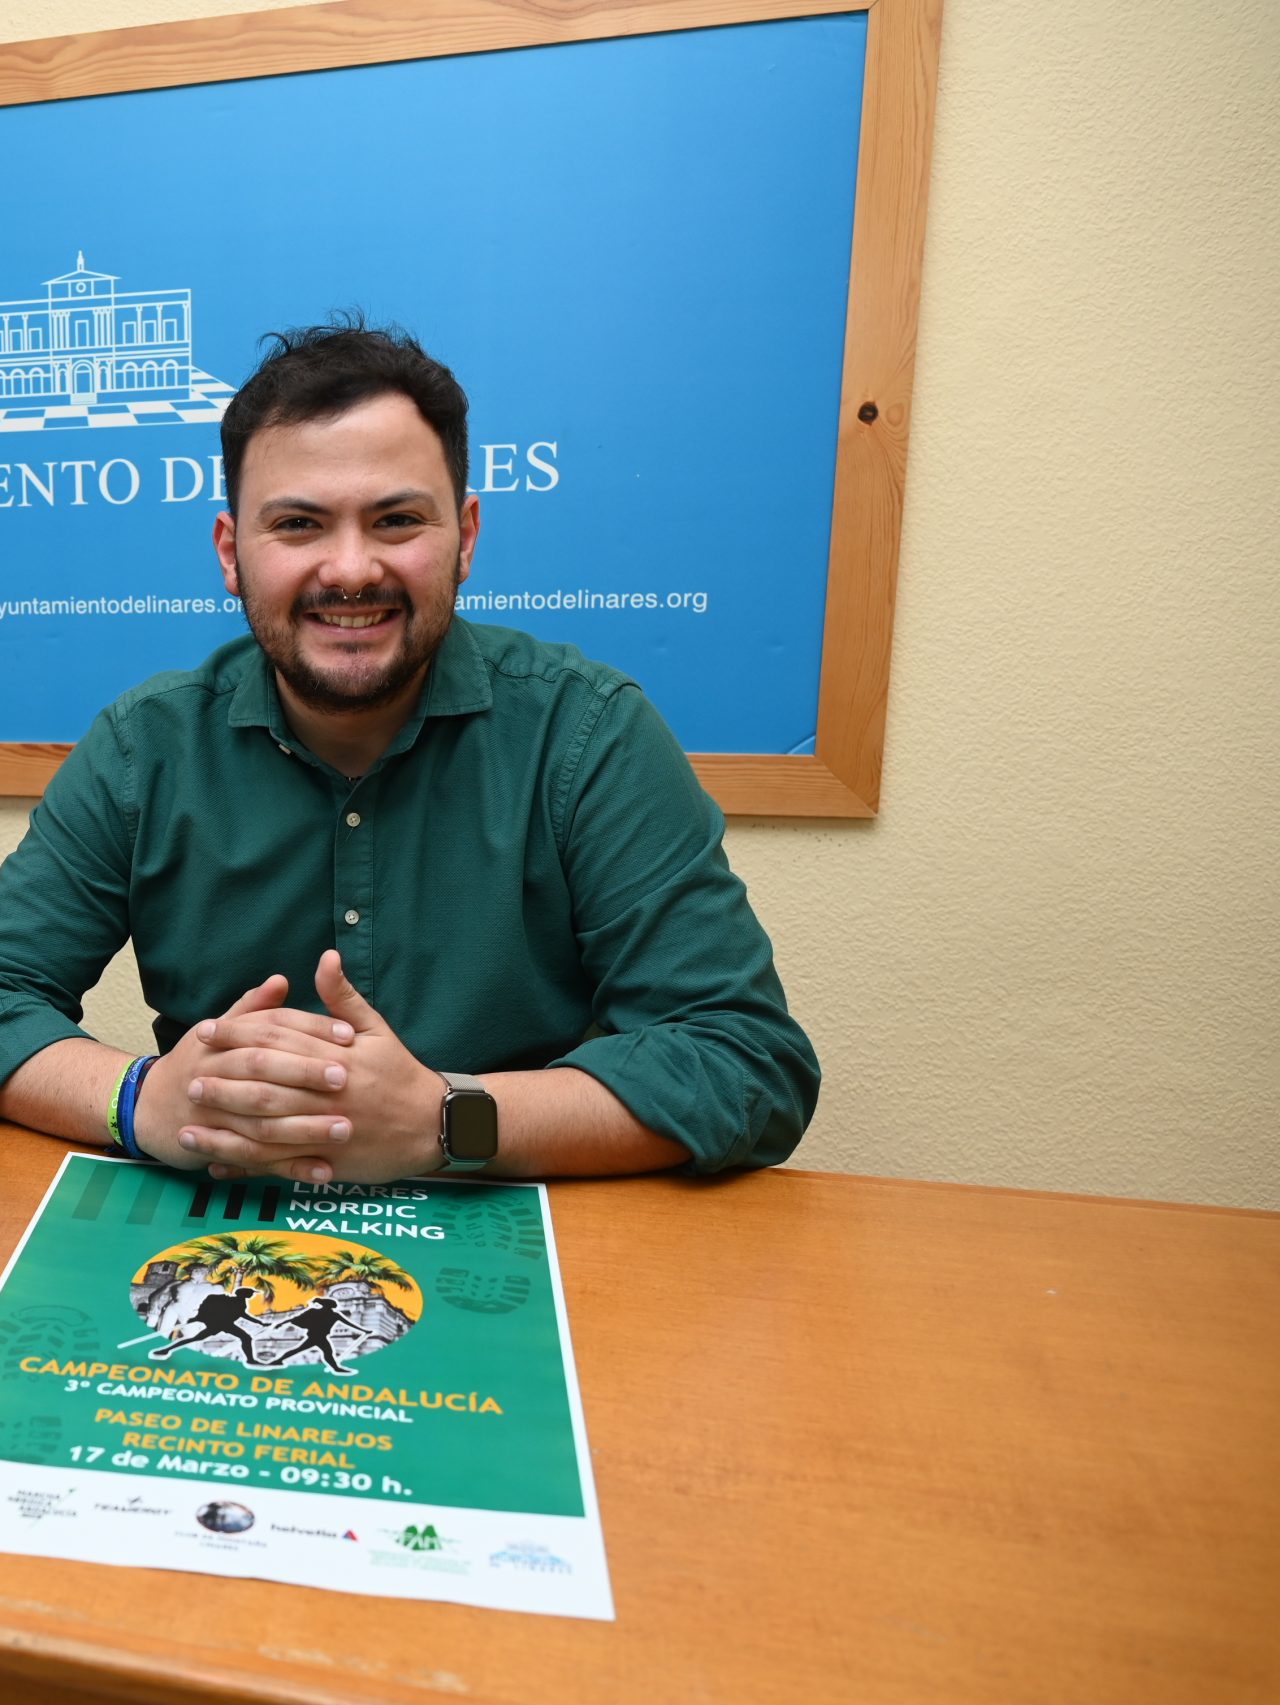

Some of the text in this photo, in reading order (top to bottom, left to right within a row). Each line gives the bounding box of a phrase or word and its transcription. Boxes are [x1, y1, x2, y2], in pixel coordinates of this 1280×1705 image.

[454, 589, 708, 613] amientodelinares.org
[289, 1199, 417, 1218] NORDIC
[293, 1181, 428, 1200] LINARES
[285, 1217, 445, 1240] WALKING
[19, 1357, 504, 1415] CAMPEONATO DE ANDALUCÍA
[96, 1382, 259, 1408] CAMPEONATO
[265, 1397, 414, 1424] PROVINCIAL
[94, 1408, 393, 1451] PASEO DE LINAREJOS
[122, 1432, 356, 1469] RECINTO FERIAL
[69, 1446, 105, 1463] 17
[111, 1450, 149, 1469] de
[156, 1453, 249, 1479] Marzo
[280, 1466, 372, 1491] 09:30
[381, 1475, 413, 1496] h.
